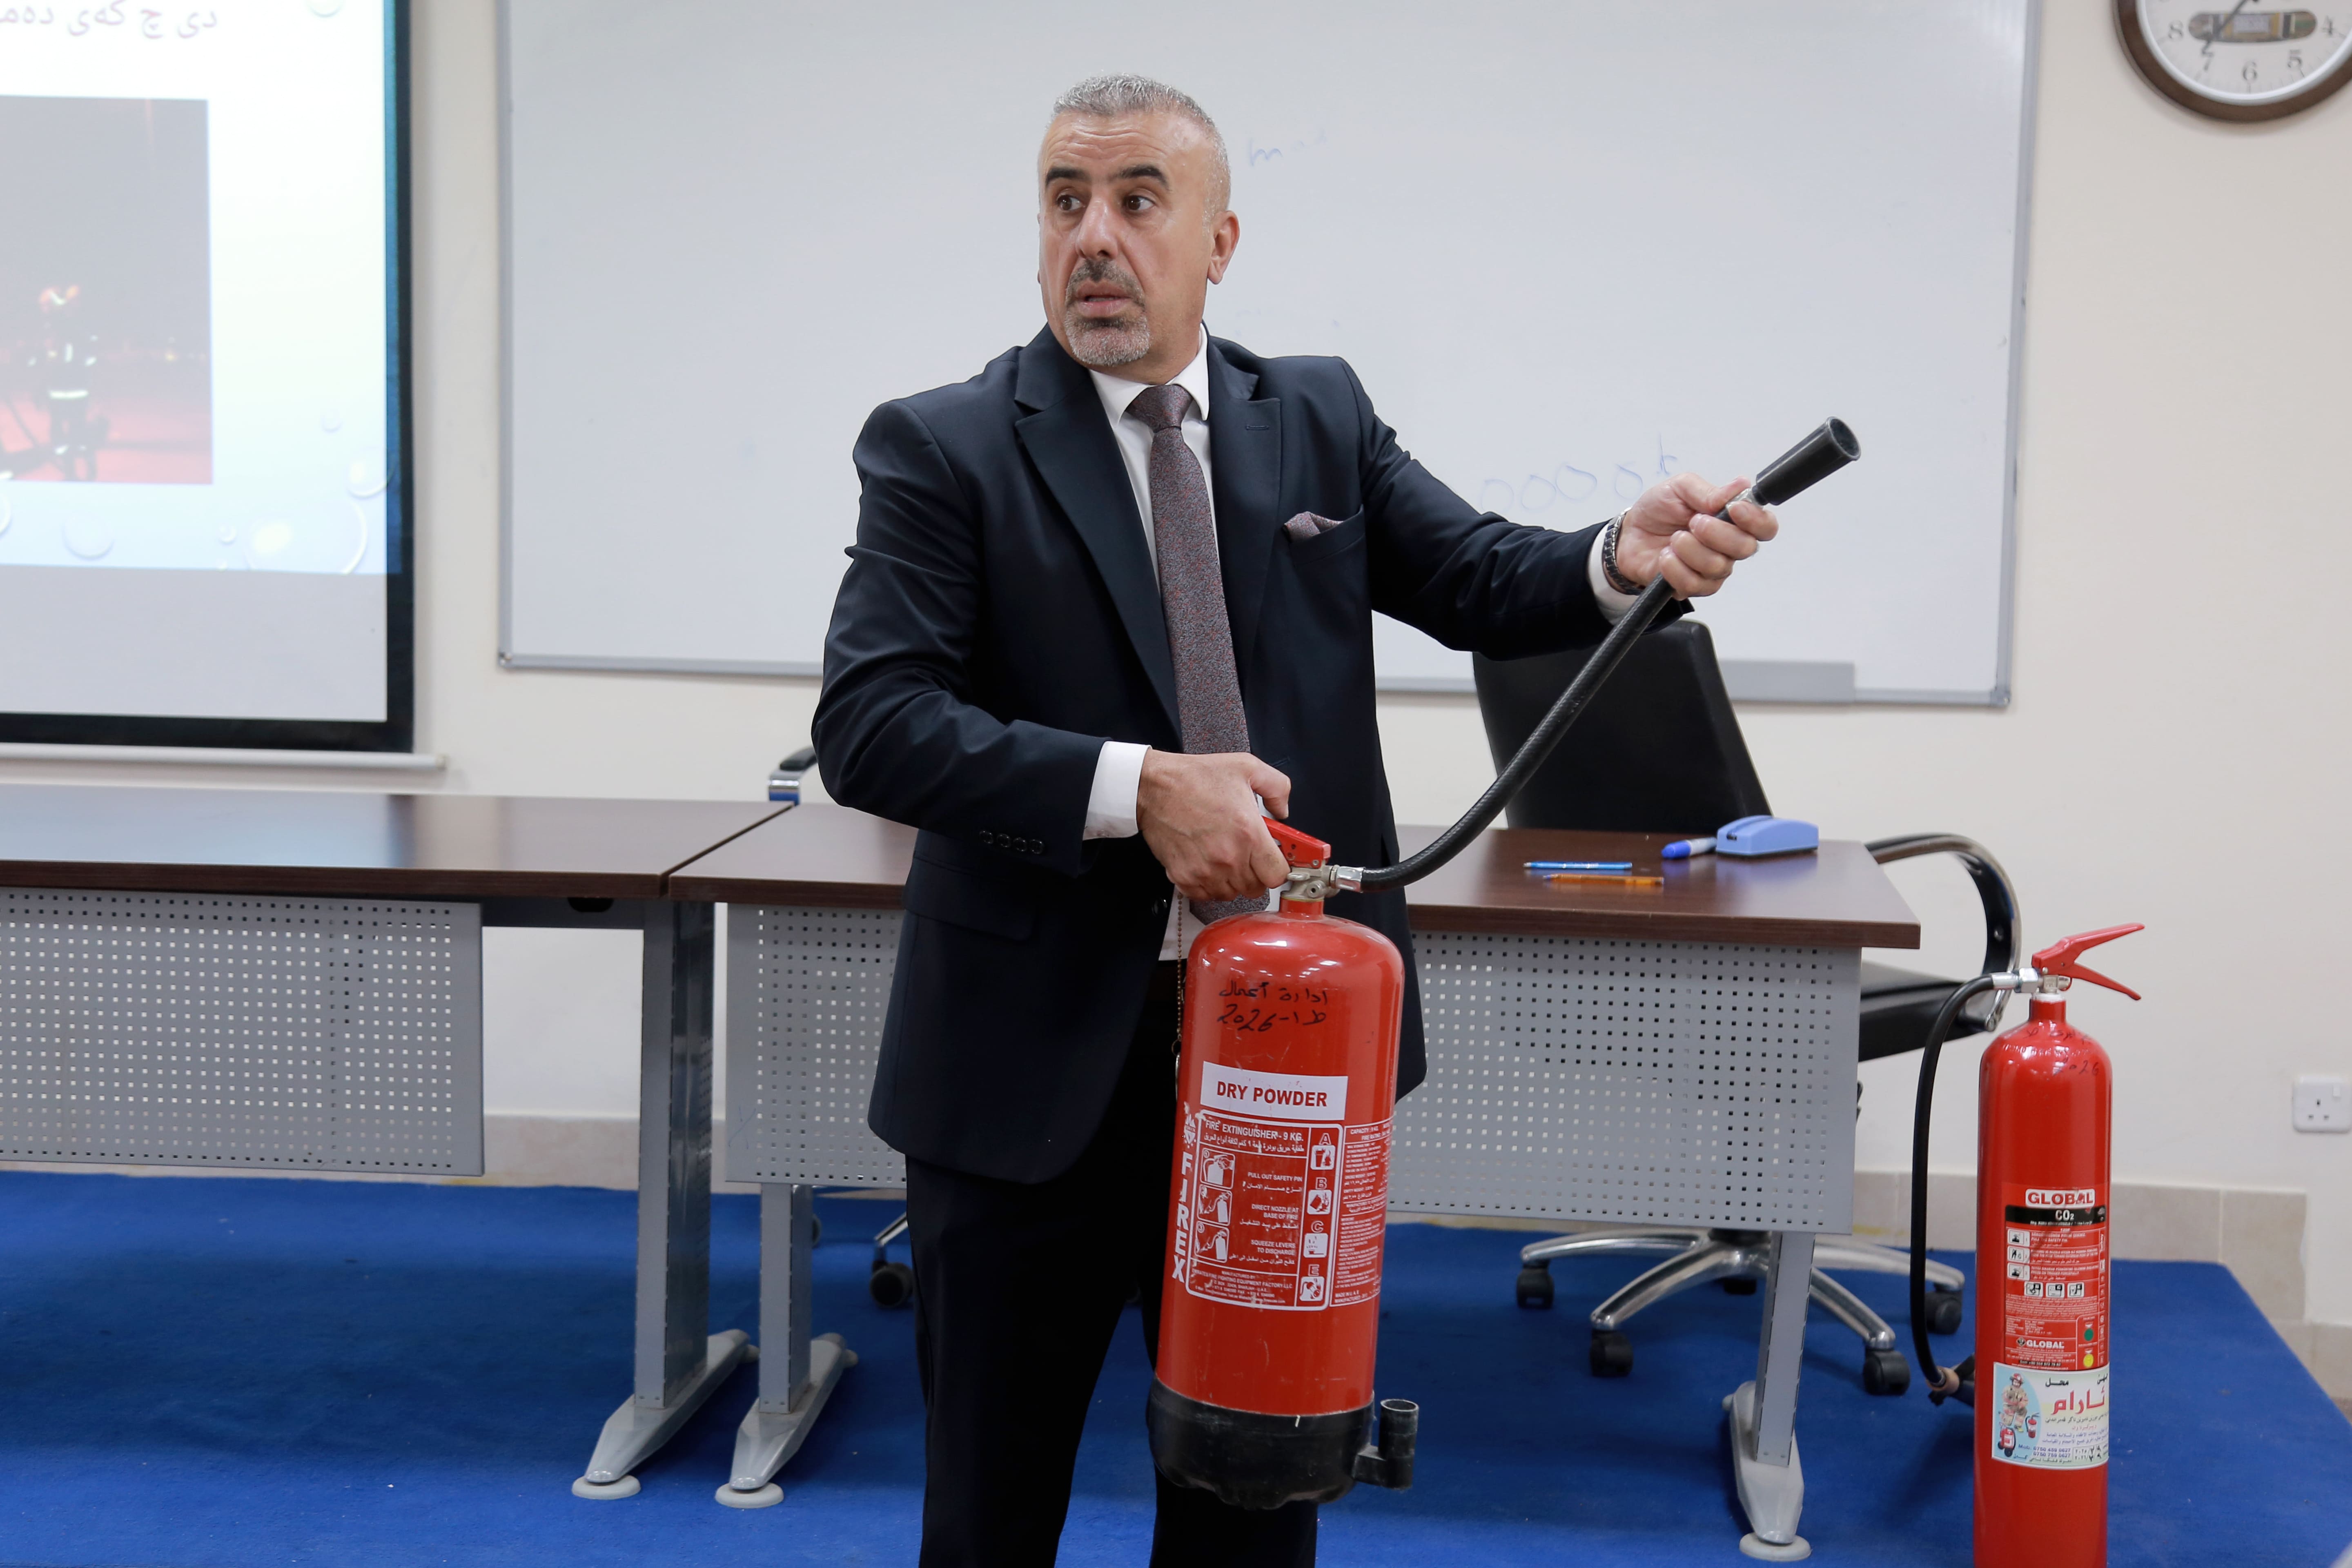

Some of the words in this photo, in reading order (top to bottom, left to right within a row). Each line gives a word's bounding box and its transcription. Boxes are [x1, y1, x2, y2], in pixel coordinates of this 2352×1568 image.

[2168, 20, 2183, 39] 8
[2322, 16, 2334, 36] 4
[2243, 61, 2257, 82] 6
[2287, 49, 2303, 69] 5
[1217, 1081, 1248, 1100] DRY
[1253, 1087, 1327, 1107] POWDER
[1206, 1120, 1220, 1131] FIRE
[1222, 1124, 1278, 1140] EXTINGUISHER
[1283, 1132, 1288, 1140] 9
[1319, 1133, 1331, 1145] A
[1315, 1177, 1327, 1189] B
[2028, 1192, 2093, 1205] GLOBAL
[1311, 1221, 1324, 1233] C
[1308, 1264, 1319, 1276] E
[2026, 1340, 2065, 1349] GLOBAL
